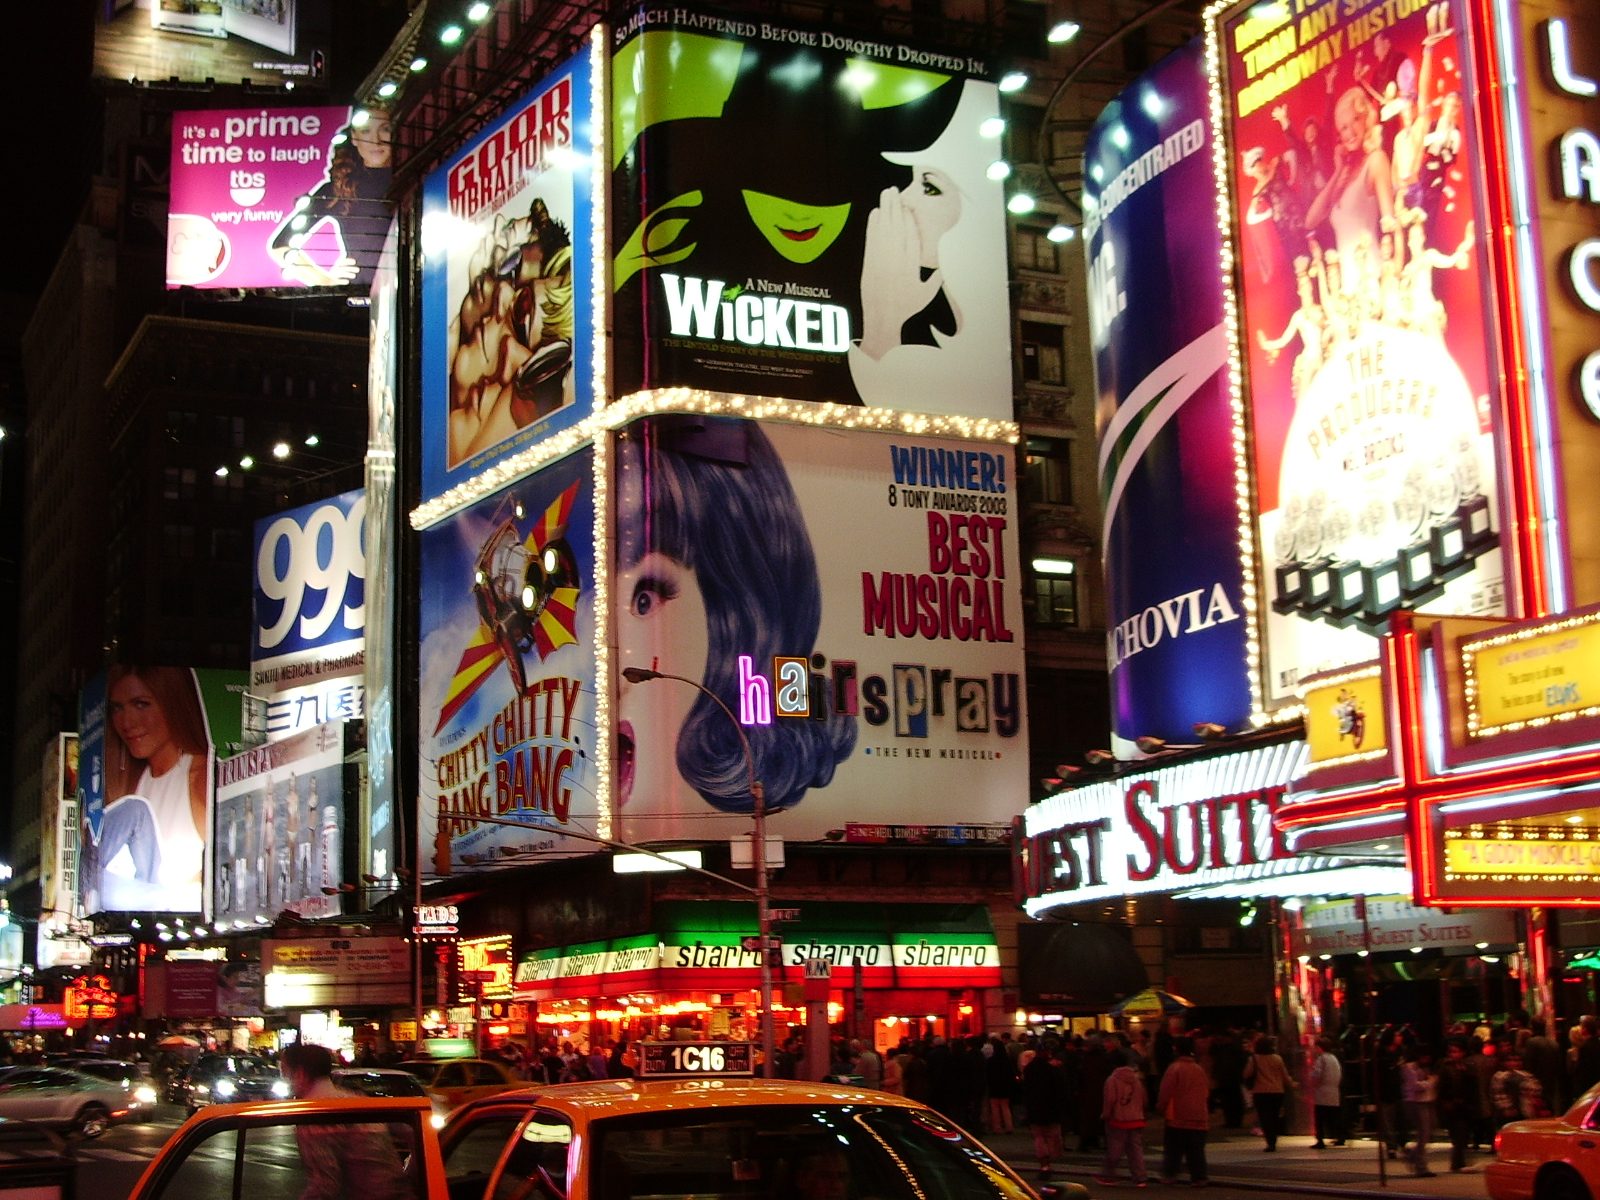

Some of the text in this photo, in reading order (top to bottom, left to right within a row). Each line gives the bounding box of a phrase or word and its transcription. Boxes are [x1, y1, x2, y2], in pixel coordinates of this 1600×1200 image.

[673, 9, 757, 37] HAPPENED
[760, 24, 817, 46] BEFORE
[821, 32, 894, 59] DOROTHY
[897, 45, 964, 71] DROPPED
[1300, 3, 1338, 46] ANY
[183, 110, 321, 144] it's a prime
[449, 79, 569, 202] GOOD
[182, 141, 321, 164] time to laugh
[230, 170, 266, 188] tbs
[211, 208, 284, 224] very funny
[745, 278, 831, 299] A NEW MUSICAL
[660, 273, 850, 353] WICKED
[890, 445, 1006, 493] WINNER!
[888, 484, 1008, 515] 8 TONY AWARDS 2003
[927, 511, 1007, 579] BEST
[862, 571, 1014, 643] MUSICAL
[739, 652, 1020, 738] hairspray
[438, 676, 582, 790] CHITTY CHITTY
[876, 747, 994, 761] THE NEW MUSICAL
[437, 746, 574, 838] BANG BANG
[792, 939, 986, 966] sbarro sbarro
[671, 1046, 725, 1071] 1C16
